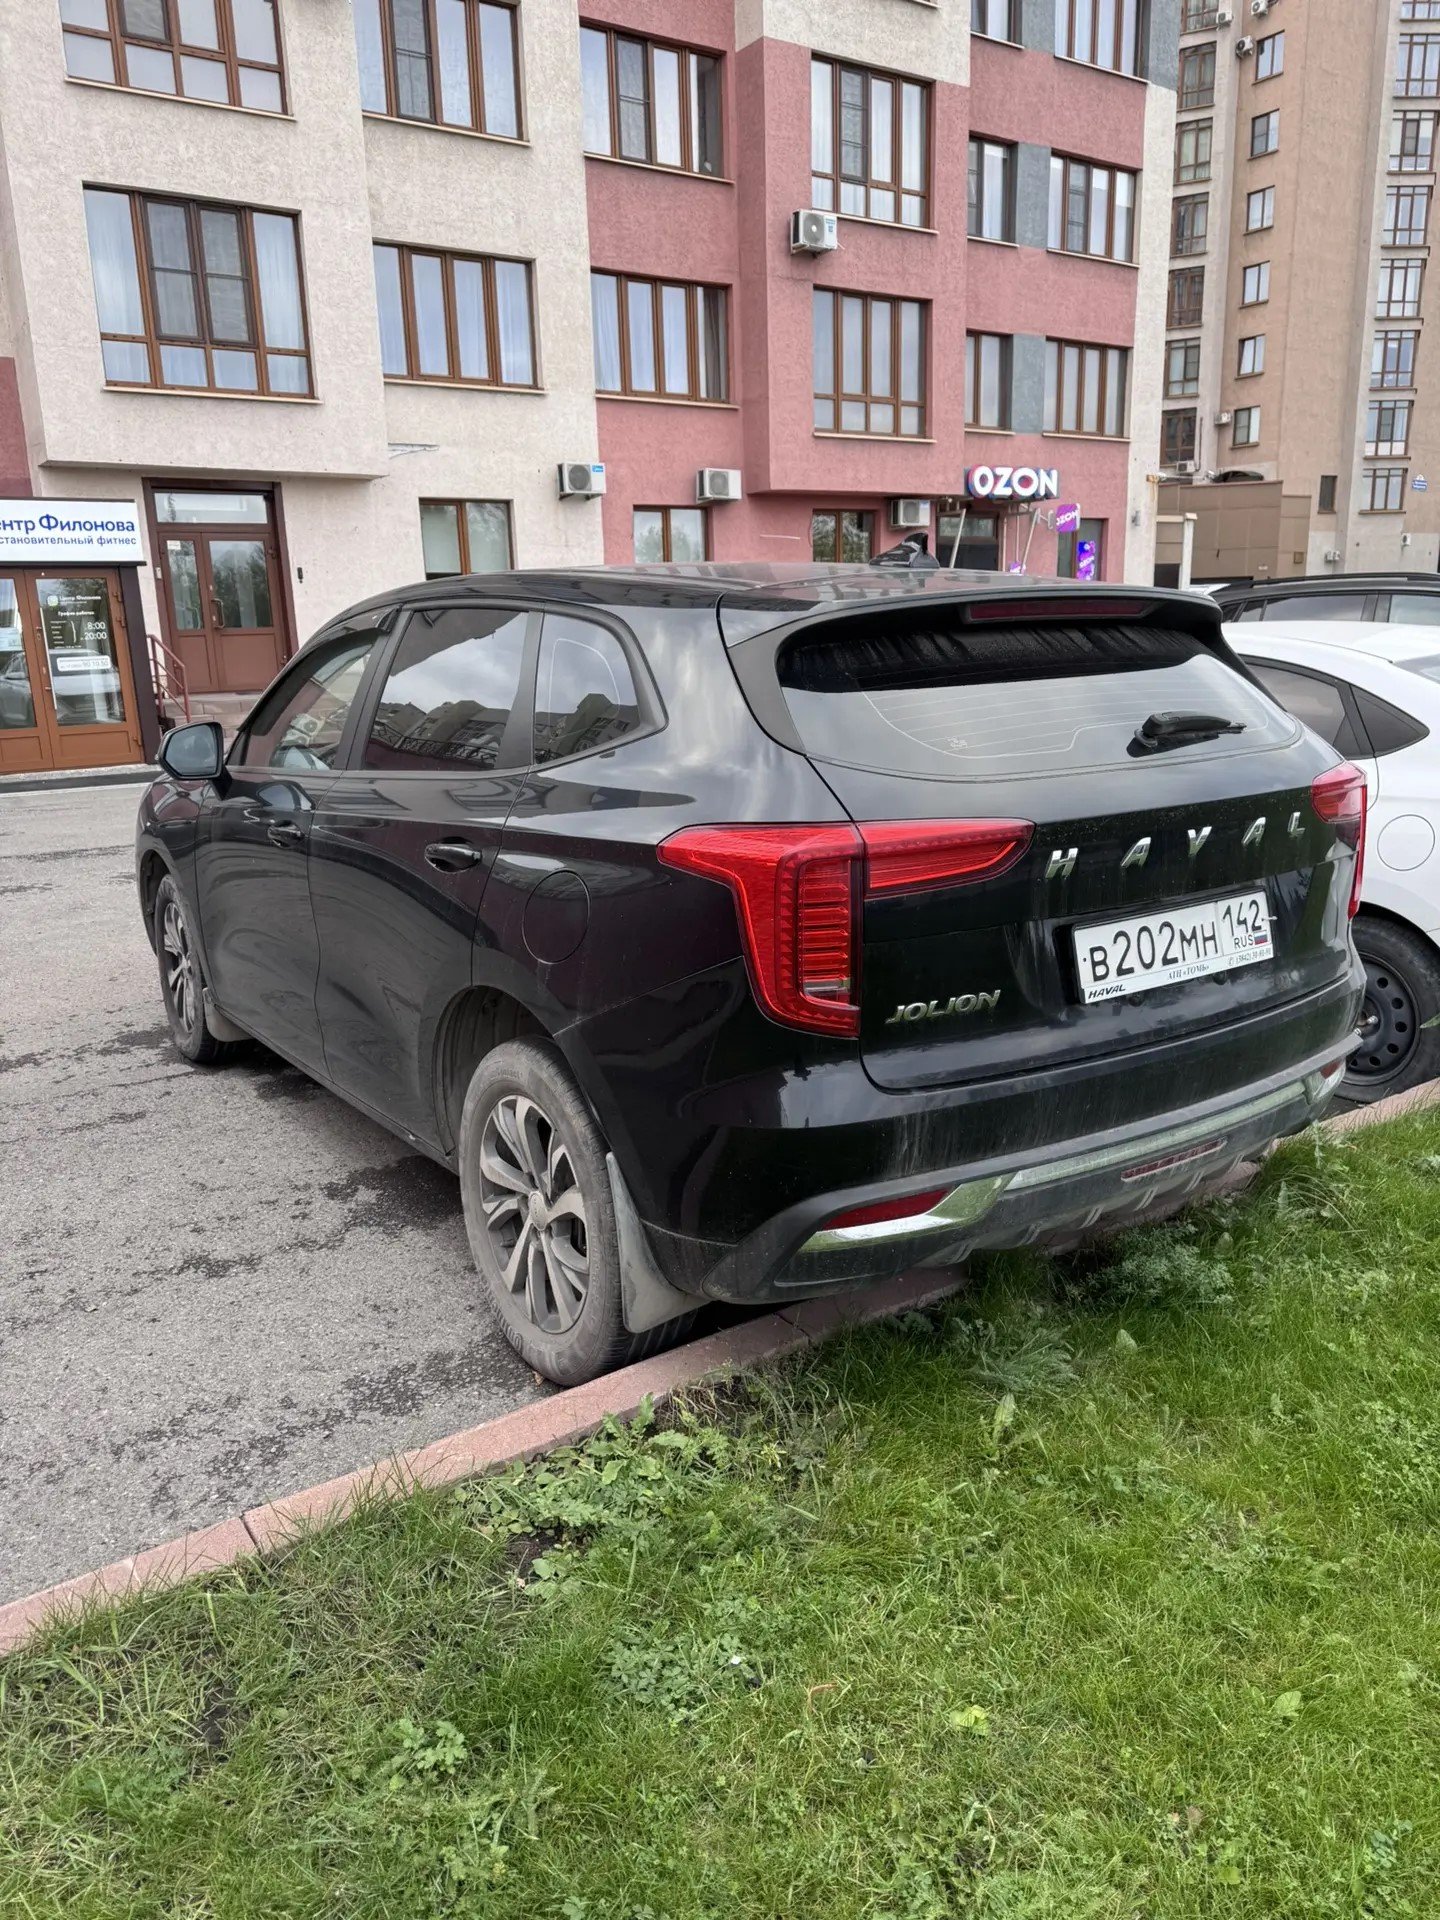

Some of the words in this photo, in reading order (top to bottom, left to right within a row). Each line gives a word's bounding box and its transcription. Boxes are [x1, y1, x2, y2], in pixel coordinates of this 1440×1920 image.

[972, 465, 1058, 497] OZON
[0, 519, 35, 535] нтр
[39, 513, 135, 532] Филонова
[97, 535, 137, 547] фитнес
[87, 621, 106, 630] 8:00
[85, 631, 107, 641] 20:00
[1045, 811, 1305, 880] HAVAL
[1222, 899, 1262, 937] 142
[1233, 934, 1253, 949] RUS
[1088, 984, 1126, 999] HAVAL
[885, 989, 1001, 1024] JOLION
